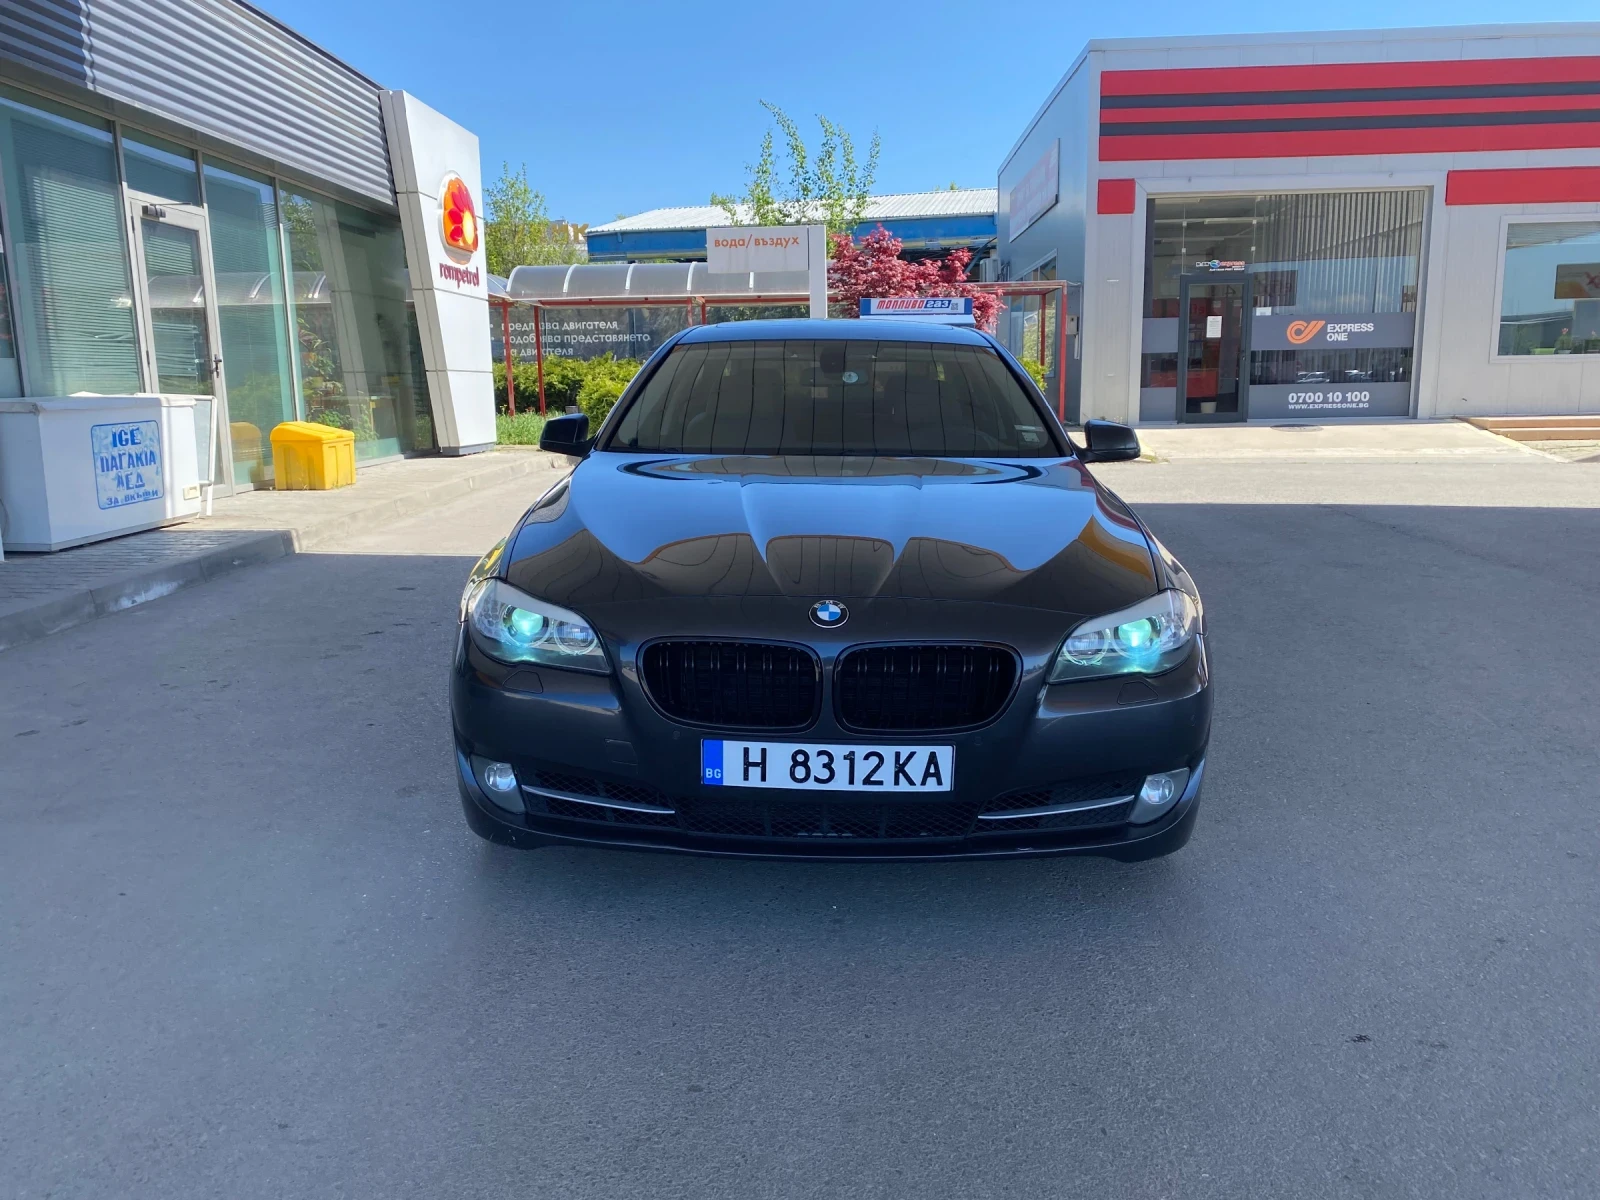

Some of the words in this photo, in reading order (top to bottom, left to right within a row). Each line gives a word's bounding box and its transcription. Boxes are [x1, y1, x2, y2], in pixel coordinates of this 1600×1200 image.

[439, 262, 480, 290] rompetrol
[501, 322, 559, 332] редпзва
[1327, 323, 1374, 333] EXPRESS
[502, 333, 561, 344] одобява
[1326, 332, 1348, 341] ONE
[520, 348, 573, 356] двиателя
[1288, 392, 1323, 403] 0700
[1327, 392, 1342, 402] 10
[1346, 391, 1370, 402] 100
[1288, 402, 1369, 410] WWW.EXPRESSONE.BG
[111, 427, 142, 448] ICE
[743, 747, 767, 782] H
[705, 768, 722, 779] BG
